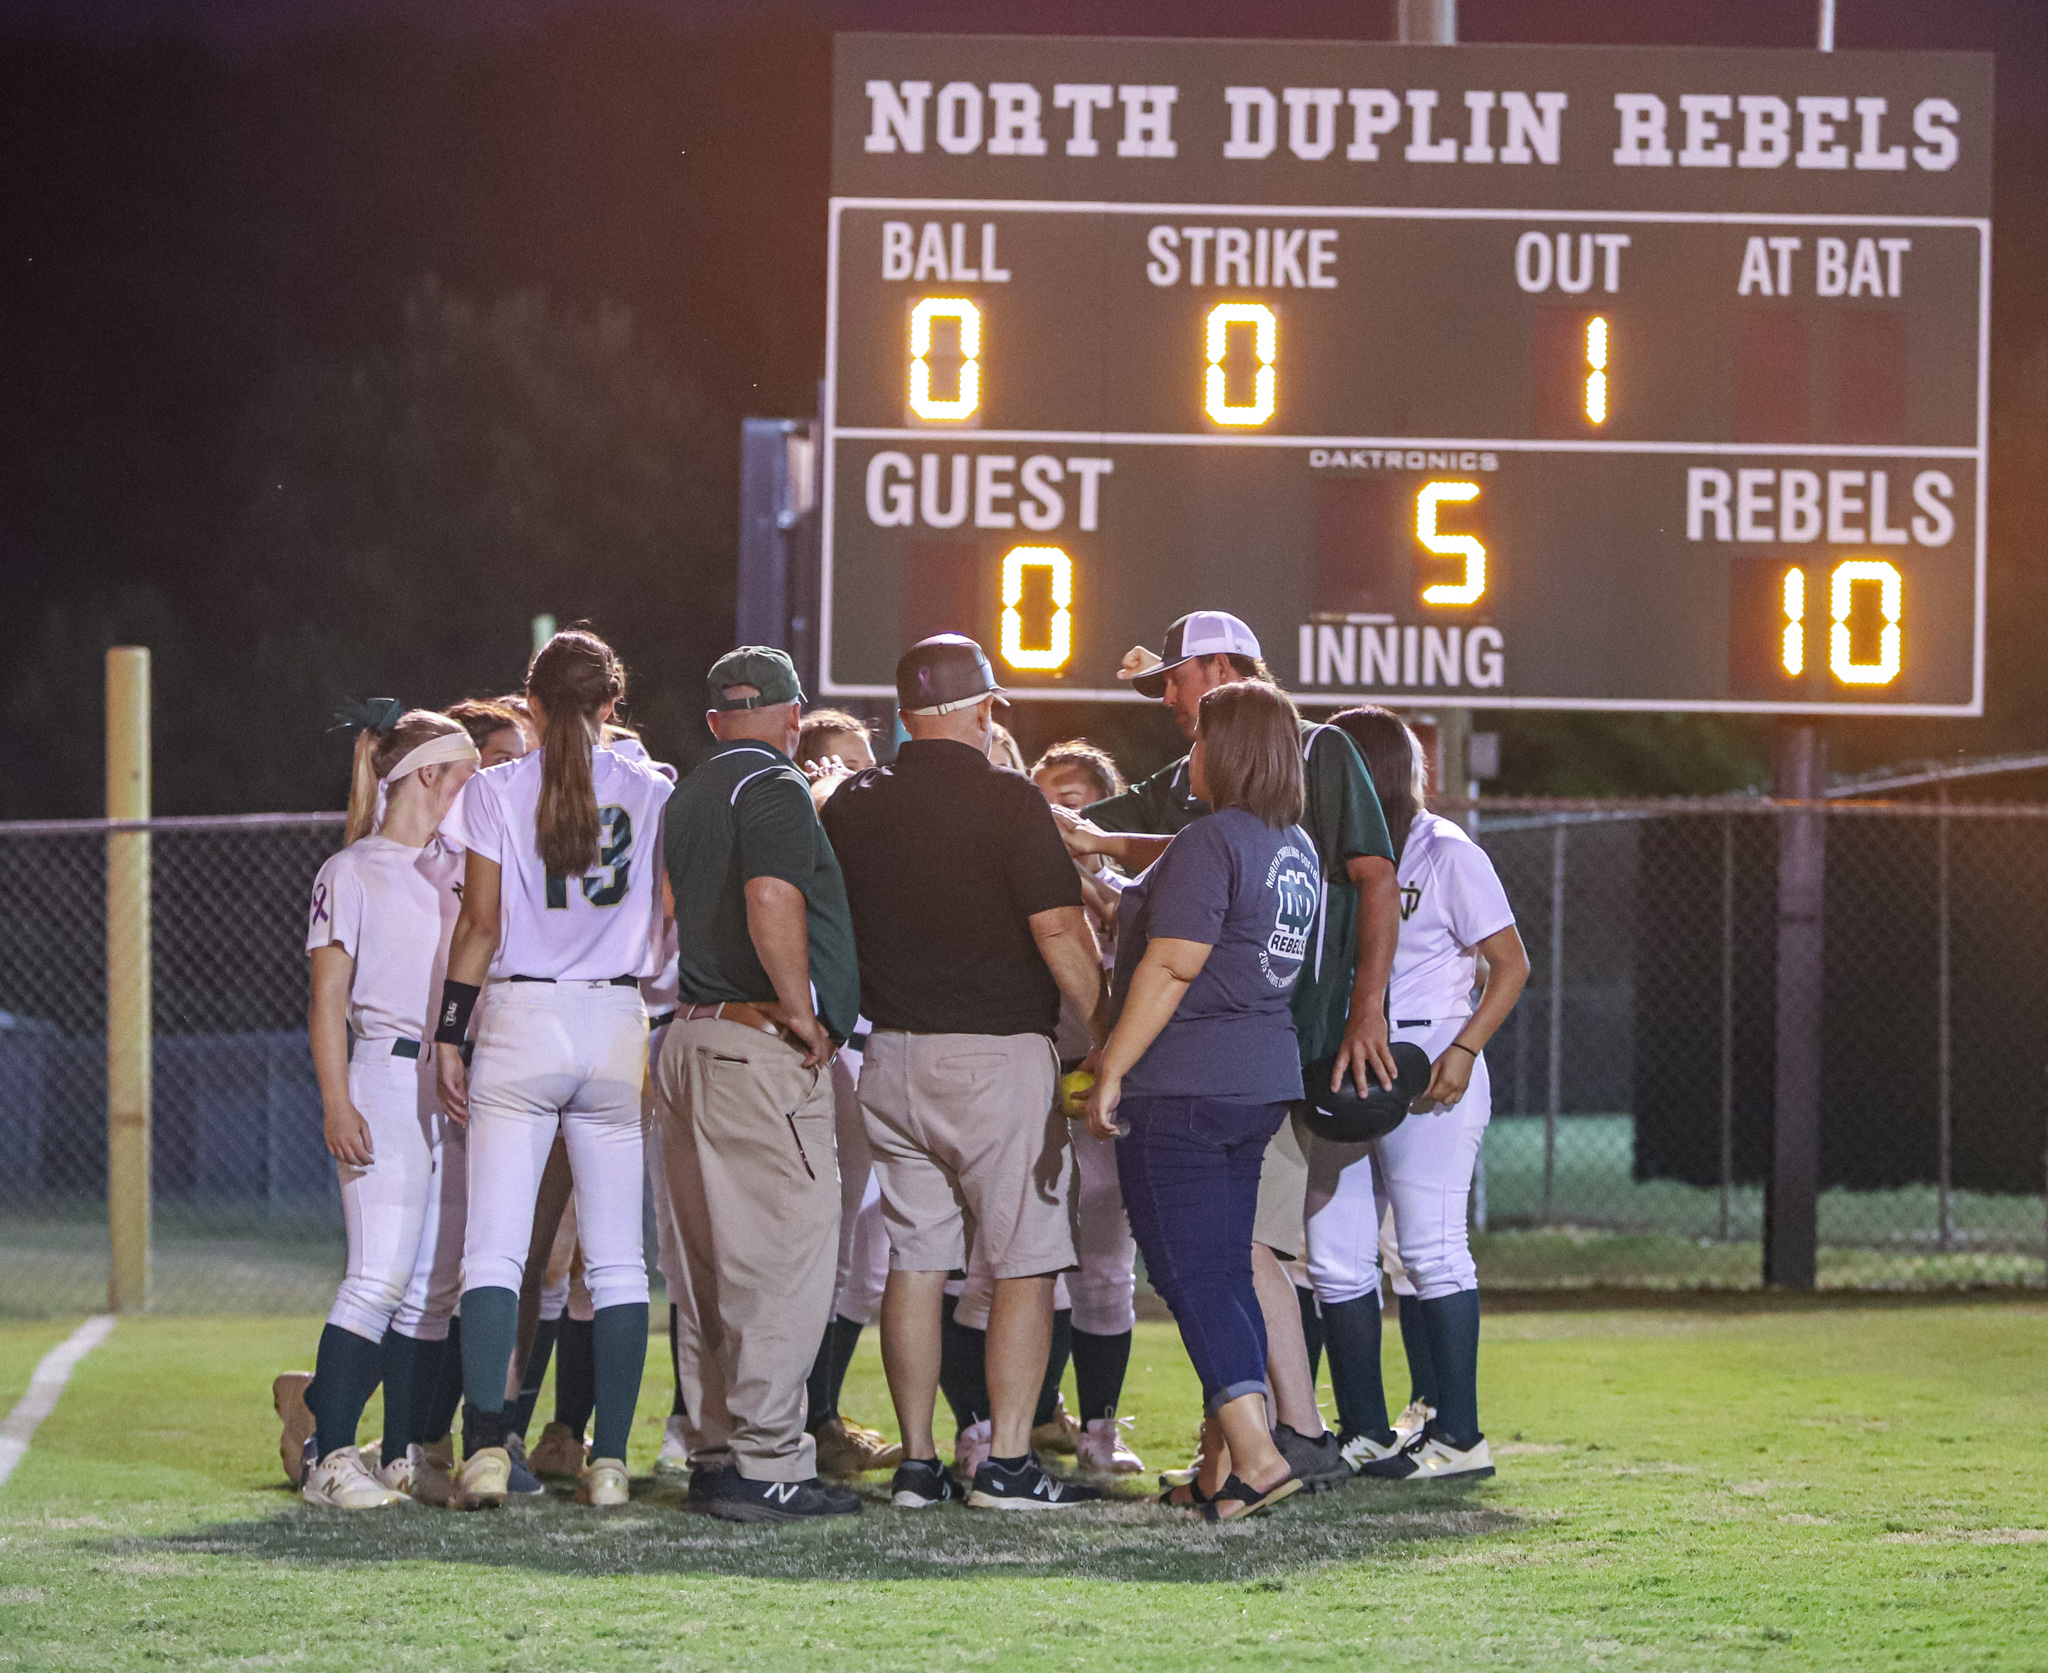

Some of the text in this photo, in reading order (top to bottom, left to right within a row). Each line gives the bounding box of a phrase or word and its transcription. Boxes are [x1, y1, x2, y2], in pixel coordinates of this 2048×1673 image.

[864, 81, 1960, 171] NORTH DUPLIN REBELS
[882, 222, 1011, 282] BALL
[1146, 227, 1339, 288] STRIKE
[1515, 232, 1631, 293] OUT
[1737, 236, 1912, 297] AT BAT
[909, 297, 981, 420] 0
[1205, 303, 1277, 425] 0
[1586, 316, 1608, 424] 1
[865, 452, 1114, 531] GUEST
[1309, 450, 1499, 471] DAKTRONICS
[1416, 482, 1487, 605] 5
[1686, 468, 1956, 546] REBELS
[1000, 546, 1073, 669] 0
[1783, 560, 1903, 684] 10
[1299, 624, 1505, 688] INNING
[1265, 855, 1281, 889] NORTH
[1270, 934, 1305, 955] REBELS
